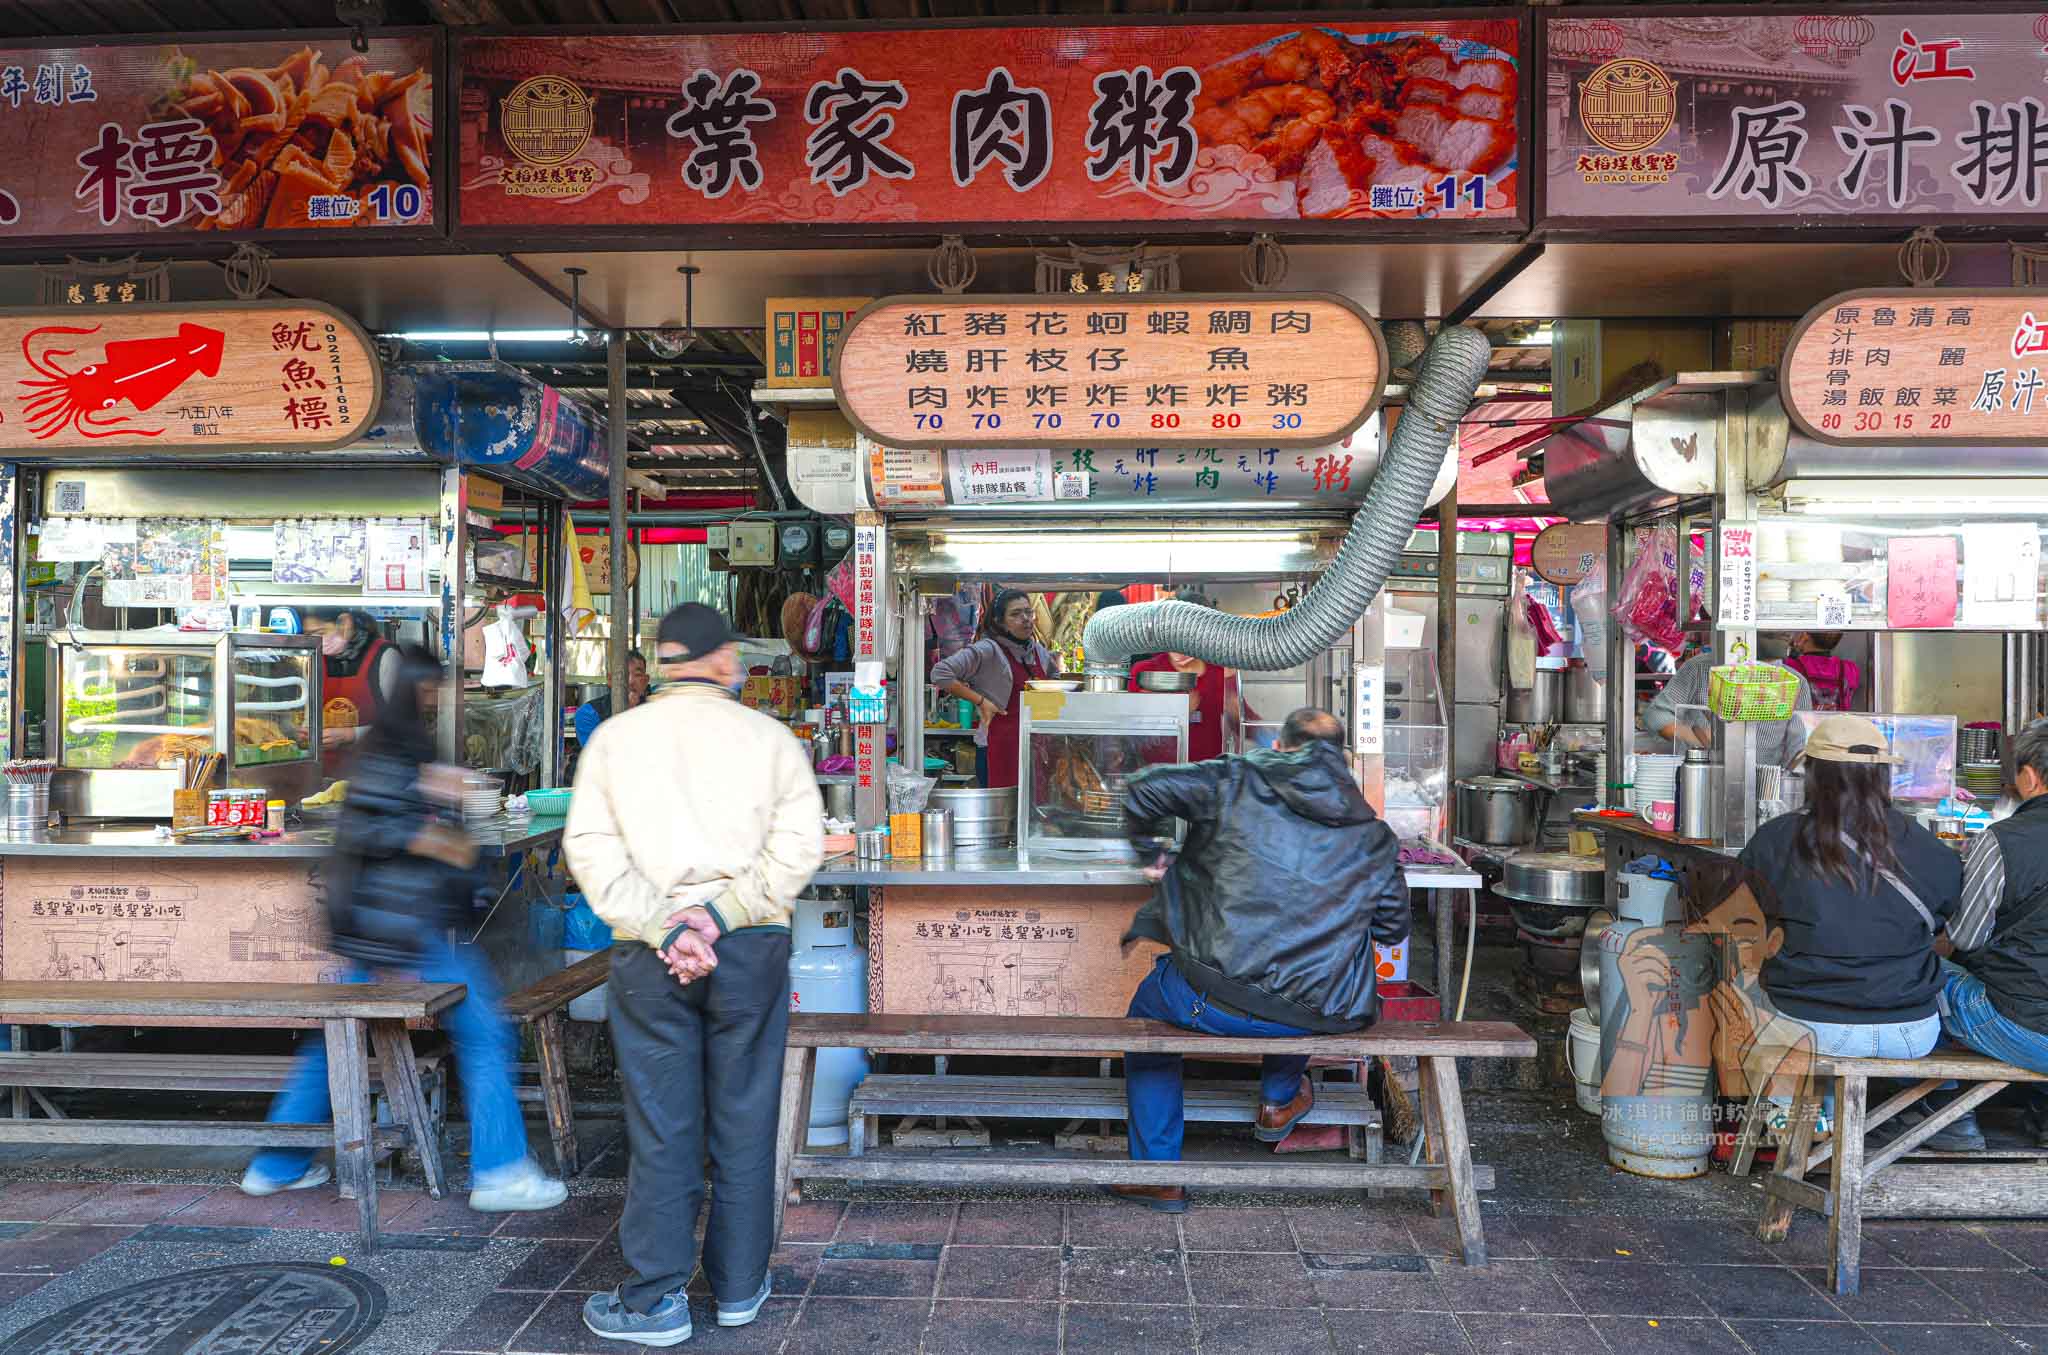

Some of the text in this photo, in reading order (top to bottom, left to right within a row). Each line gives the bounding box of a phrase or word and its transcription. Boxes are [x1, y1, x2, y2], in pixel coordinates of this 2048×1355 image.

[2, 64, 97, 107] 年創立
[667, 66, 1202, 197] 葉家肉粥
[367, 184, 421, 219] 10
[1434, 174, 1486, 210] 11
[1576, 152, 1679, 173] 大稻埕慈聖宮
[1585, 174, 1668, 182] DA DAO CHENG
[165, 406, 234, 421] 一九五八年
[271, 321, 333, 431] 魷魚標
[324, 323, 350, 425] 0922111682
[903, 312, 948, 430] 紅燒肉 70
[964, 312, 1009, 430] 豬肝炸 70
[1025, 311, 1069, 429] 花枝炸 70
[1085, 311, 1129, 429] 蚵仔炸 70
[1145, 310, 1190, 429] 蝦炸 80
[1205, 310, 1250, 429] 鯛魚炸 80
[1265, 309, 1312, 430] 肉粥 30
[1821, 307, 1861, 429] 原汁排骨湯 80
[1854, 307, 1897, 431] 魯肉飯 30
[1894, 307, 1936, 429] 清飯 15
[1929, 307, 1973, 429] 高麗菜 20
[192, 423, 222, 436] 創立
[972, 481, 1026, 495] 排隊點餐
[1359, 736, 1377, 745] 9:00
[32, 900, 105, 916] 慈聖宮小吃
[111, 902, 182, 918] 慈聖宮小吃
[915, 923, 992, 938] 慈聖宮小吃
[1000, 925, 1075, 939] 慈聖宮小吃
